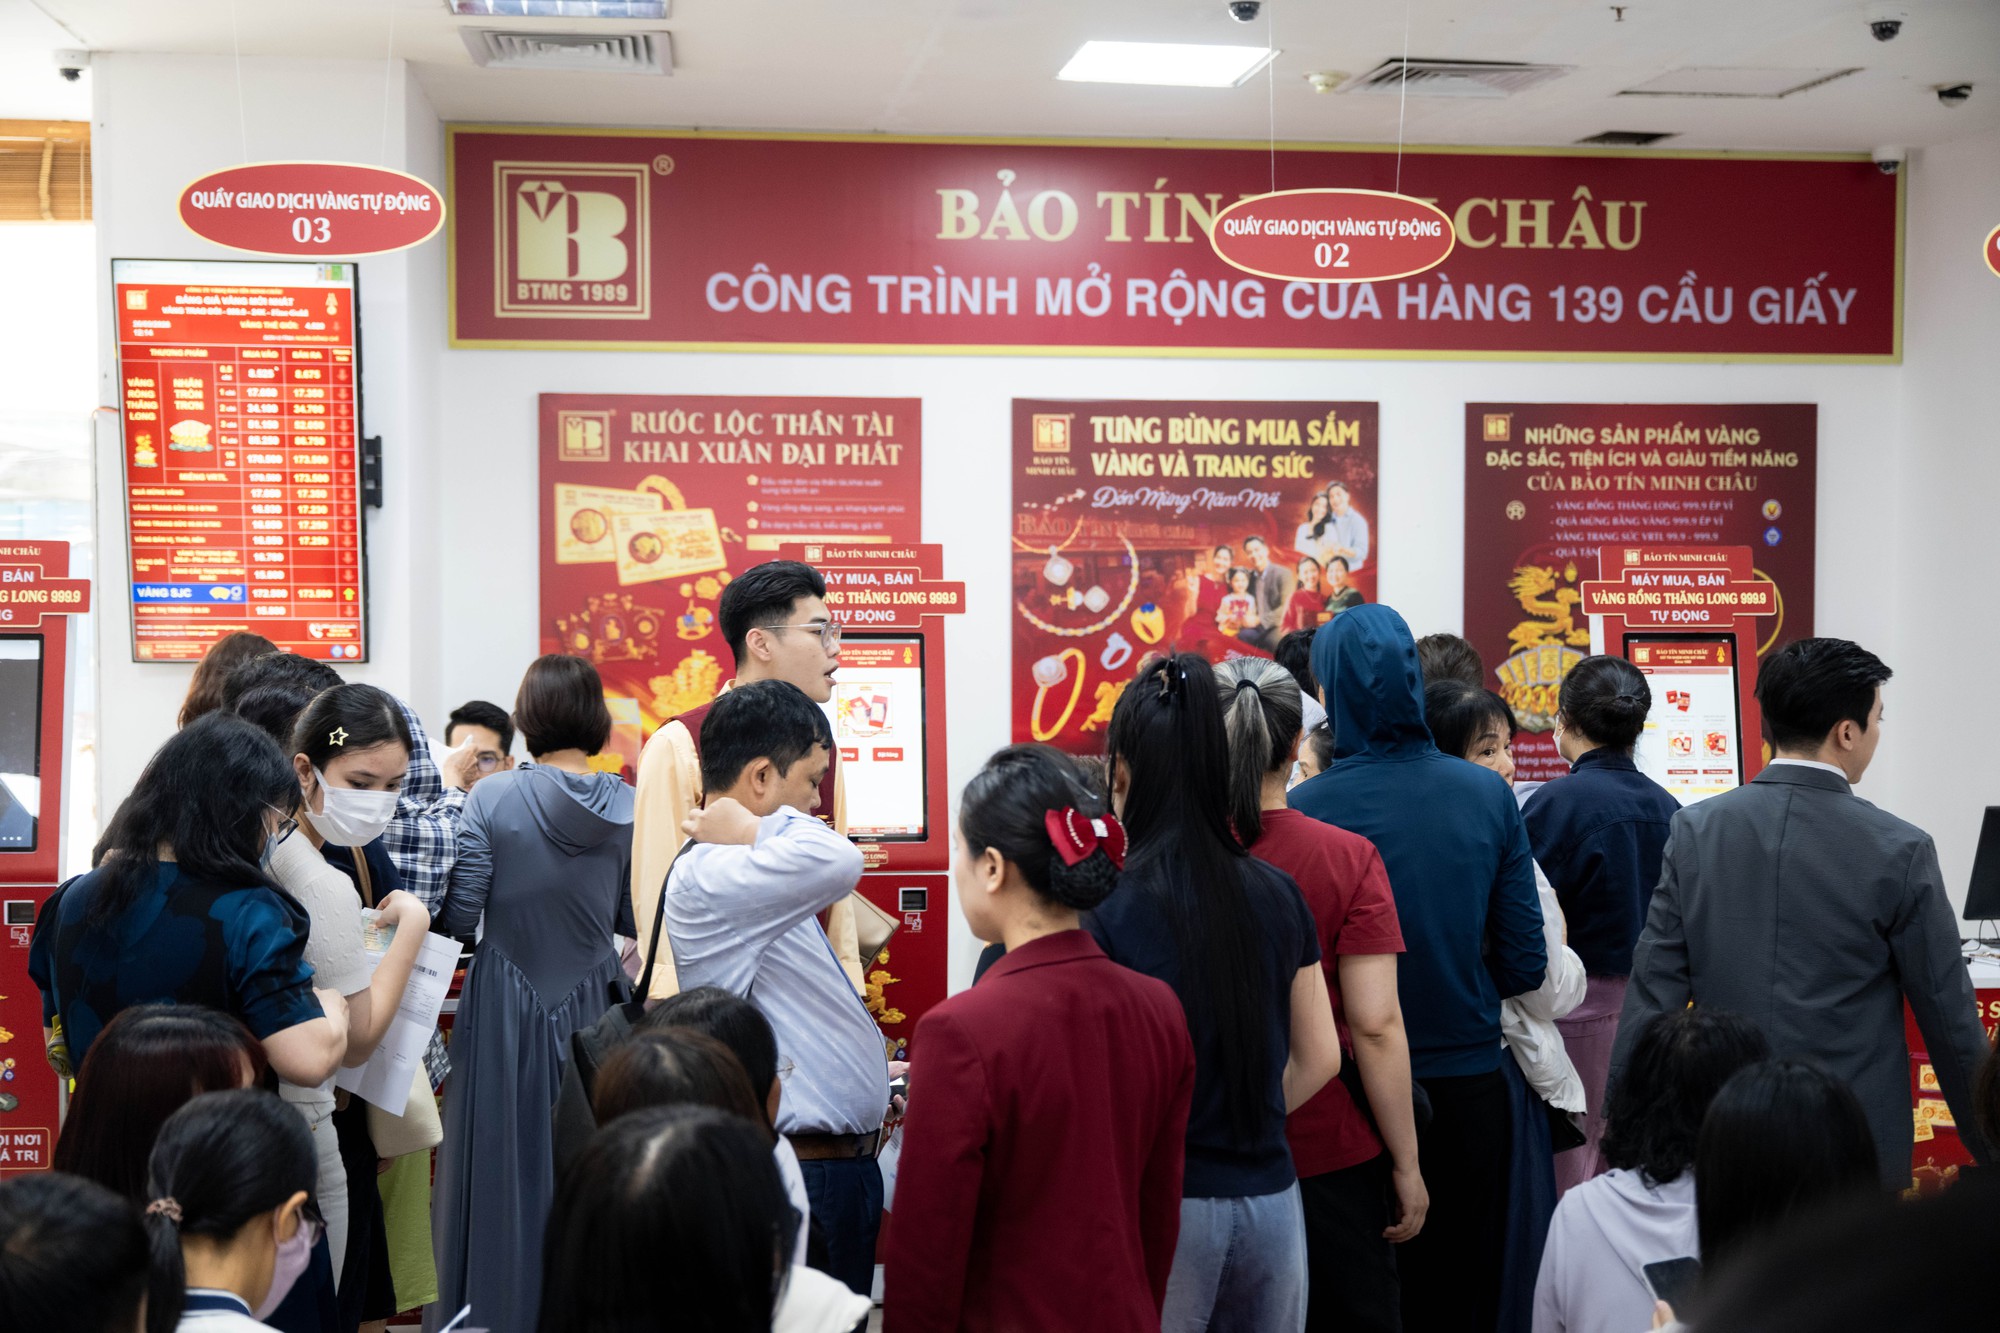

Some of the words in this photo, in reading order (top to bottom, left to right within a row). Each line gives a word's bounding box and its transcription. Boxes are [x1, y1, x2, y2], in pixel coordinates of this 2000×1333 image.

[191, 188, 233, 208] QUẦY
[236, 192, 274, 210] GIAO
[277, 193, 315, 214] DỊCH
[316, 189, 359, 211] VÀNG
[360, 191, 382, 214] TỰ
[383, 191, 430, 215] ĐỘNG
[936, 169, 1079, 242] BẢO
[1454, 186, 1647, 250] CHÂU
[292, 217, 332, 244] 03
[1224, 216, 1262, 235] QUẦY
[1264, 221, 1299, 236] GIAO
[1301, 221, 1335, 239] DỊCH
[1337, 218, 1376, 236] VÀNG
[1377, 219, 1398, 240] TỰ
[1399, 218, 1441, 240] ĐỘNG
[1314, 243, 1350, 268] 02
[518, 282, 571, 301] BTMC
[580, 283, 628, 302] 1989
[706, 263, 851, 314] CÔNG
[867, 266, 1018, 316] TRÌNH
[1036, 263, 1111, 317] MỞ
[1127, 269, 1266, 325] RỘNG
[1397, 273, 1531, 322] HÀNG
[1548, 286, 1623, 324] 139
[1638, 271, 1732, 325] CẦU
[1749, 271, 1857, 325] GIẤY
[630, 409, 705, 434] RƯỚC
[713, 409, 764, 437] LỘC
[852, 411, 894, 437] TÀI
[1246, 419, 1302, 446] MUA
[1307, 411, 1360, 447] SẮM
[1525, 423, 1595, 445] NHỮNG
[1600, 425, 1640, 445] SẢN
[1705, 424, 1761, 445] VÀNG
[624, 441, 690, 463] KHAI
[698, 439, 772, 464] XUÂN
[782, 442, 826, 468] ĐẠI
[835, 440, 903, 466] PHÁT
[1486, 448, 1523, 470] ĐẶC
[1526, 446, 1565, 469] SẮC,
[1569, 448, 1604, 471] TIỆN
[1608, 449, 1636, 467] ÍCH
[1640, 449, 1662, 467] VÀ
[1665, 448, 1706, 467] GIÀU
[1751, 449, 1799, 467] NĂNG
[1090, 448, 1155, 477] VÀNG
[1158, 449, 1190, 477] VÀ
[1193, 454, 1268, 478] TRANG
[1271, 451, 1314, 479] SỨC
[1527, 471, 1566, 491] CỦA
[1571, 471, 1610, 491] BẢO
[1613, 471, 1646, 491] TÍN
[1650, 475, 1700, 491] MINH
[1705, 471, 1758, 491] CHÂU
[1091, 486, 1134, 508] Đón
[1192, 487, 1239, 510] Năm
[1556, 500, 1585, 511] VÀNG
[1653, 501, 1680, 511] LONG
[1556, 515, 1577, 526] QUÀ
[1642, 515, 1670, 526] VÀNG
[1556, 530, 1585, 541] VÀNG
[1587, 532, 1619, 541] TRANG
[13, 547, 41, 556] CHÂU
[826, 549, 846, 559] BẢO
[847, 548, 863, 559] TÍN
[864, 550, 890, 559] MINH
[891, 549, 917, 559] CHÂU
[1579, 547, 1600, 560] TẶN
[1644, 552, 1665, 562] BẢO
[1665, 551, 1680, 562] TÍN
[1682, 554, 1704, 562] MINH
[1705, 552, 1728, 563] CHÂU
[2, 569, 35, 583] BÁN
[823, 571, 842, 585] ÁY
[846, 574, 881, 586] MUA,
[884, 571, 914, 585] BÁN
[1631, 573, 1659, 586] MÁY
[1662, 575, 1695, 588] MUA,
[1698, 573, 1725, 586] BÁN
[11, 590, 48, 603] LONG
[51, 590, 82, 603] 999.9
[137, 586, 169, 598] VÀNG
[170, 587, 193, 598] SJC
[824, 592, 845, 604] NG
[846, 589, 891, 605] THĂNG
[893, 592, 927, 605] LONG
[929, 592, 958, 605] 999.9
[1592, 589, 1626, 605] VÀNG
[1628, 588, 1661, 605] RỒNG
[1663, 590, 1704, 605] THĂNG
[1706, 592, 1738, 605] LONG
[1740, 592, 1767, 605] 999.9
[831, 609, 852, 623] TỰ
[855, 609, 896, 624] ĐỘNG
[1650, 609, 1670, 624] TỰ
[1671, 609, 1710, 624] ĐỘNG
[14, 1134, 41, 1146] NƠI
[14, 1150, 39, 1164] TRỊ
